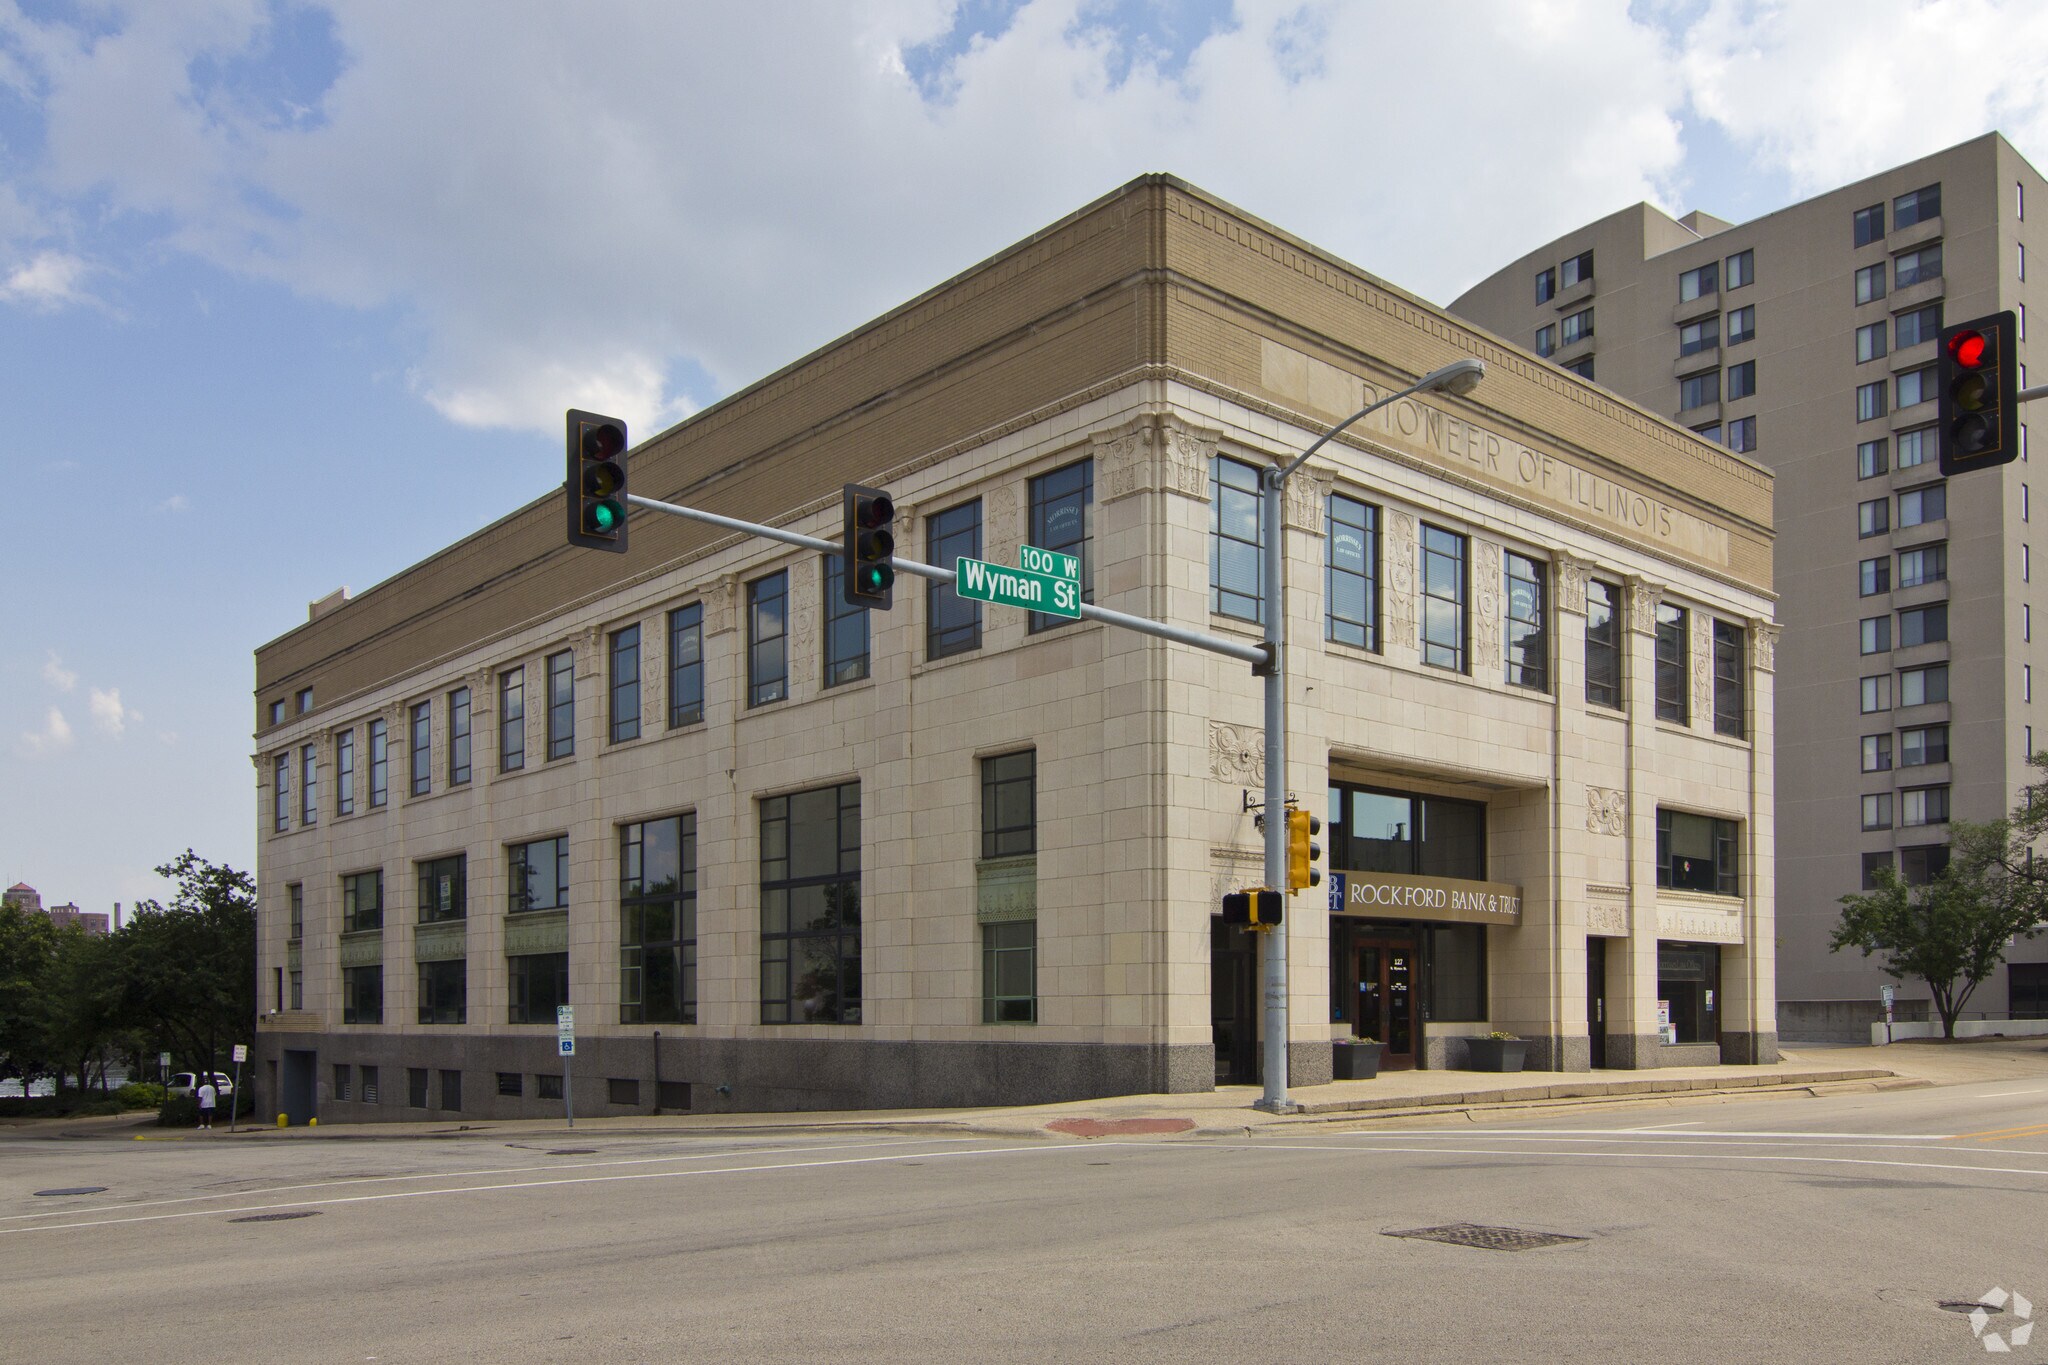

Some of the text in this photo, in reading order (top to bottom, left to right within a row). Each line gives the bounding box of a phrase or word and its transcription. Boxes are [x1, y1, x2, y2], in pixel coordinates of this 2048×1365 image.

[1362, 383, 1671, 536] PIONEER OF ILLINOIS
[1047, 506, 1079, 524] MORRISSEY
[1334, 534, 1362, 551] MORRISSEY
[1022, 548, 1077, 578] 100 W
[965, 561, 1076, 610] Wyman St
[1350, 884, 1521, 915] ROCKFORD BANK & TRUST
